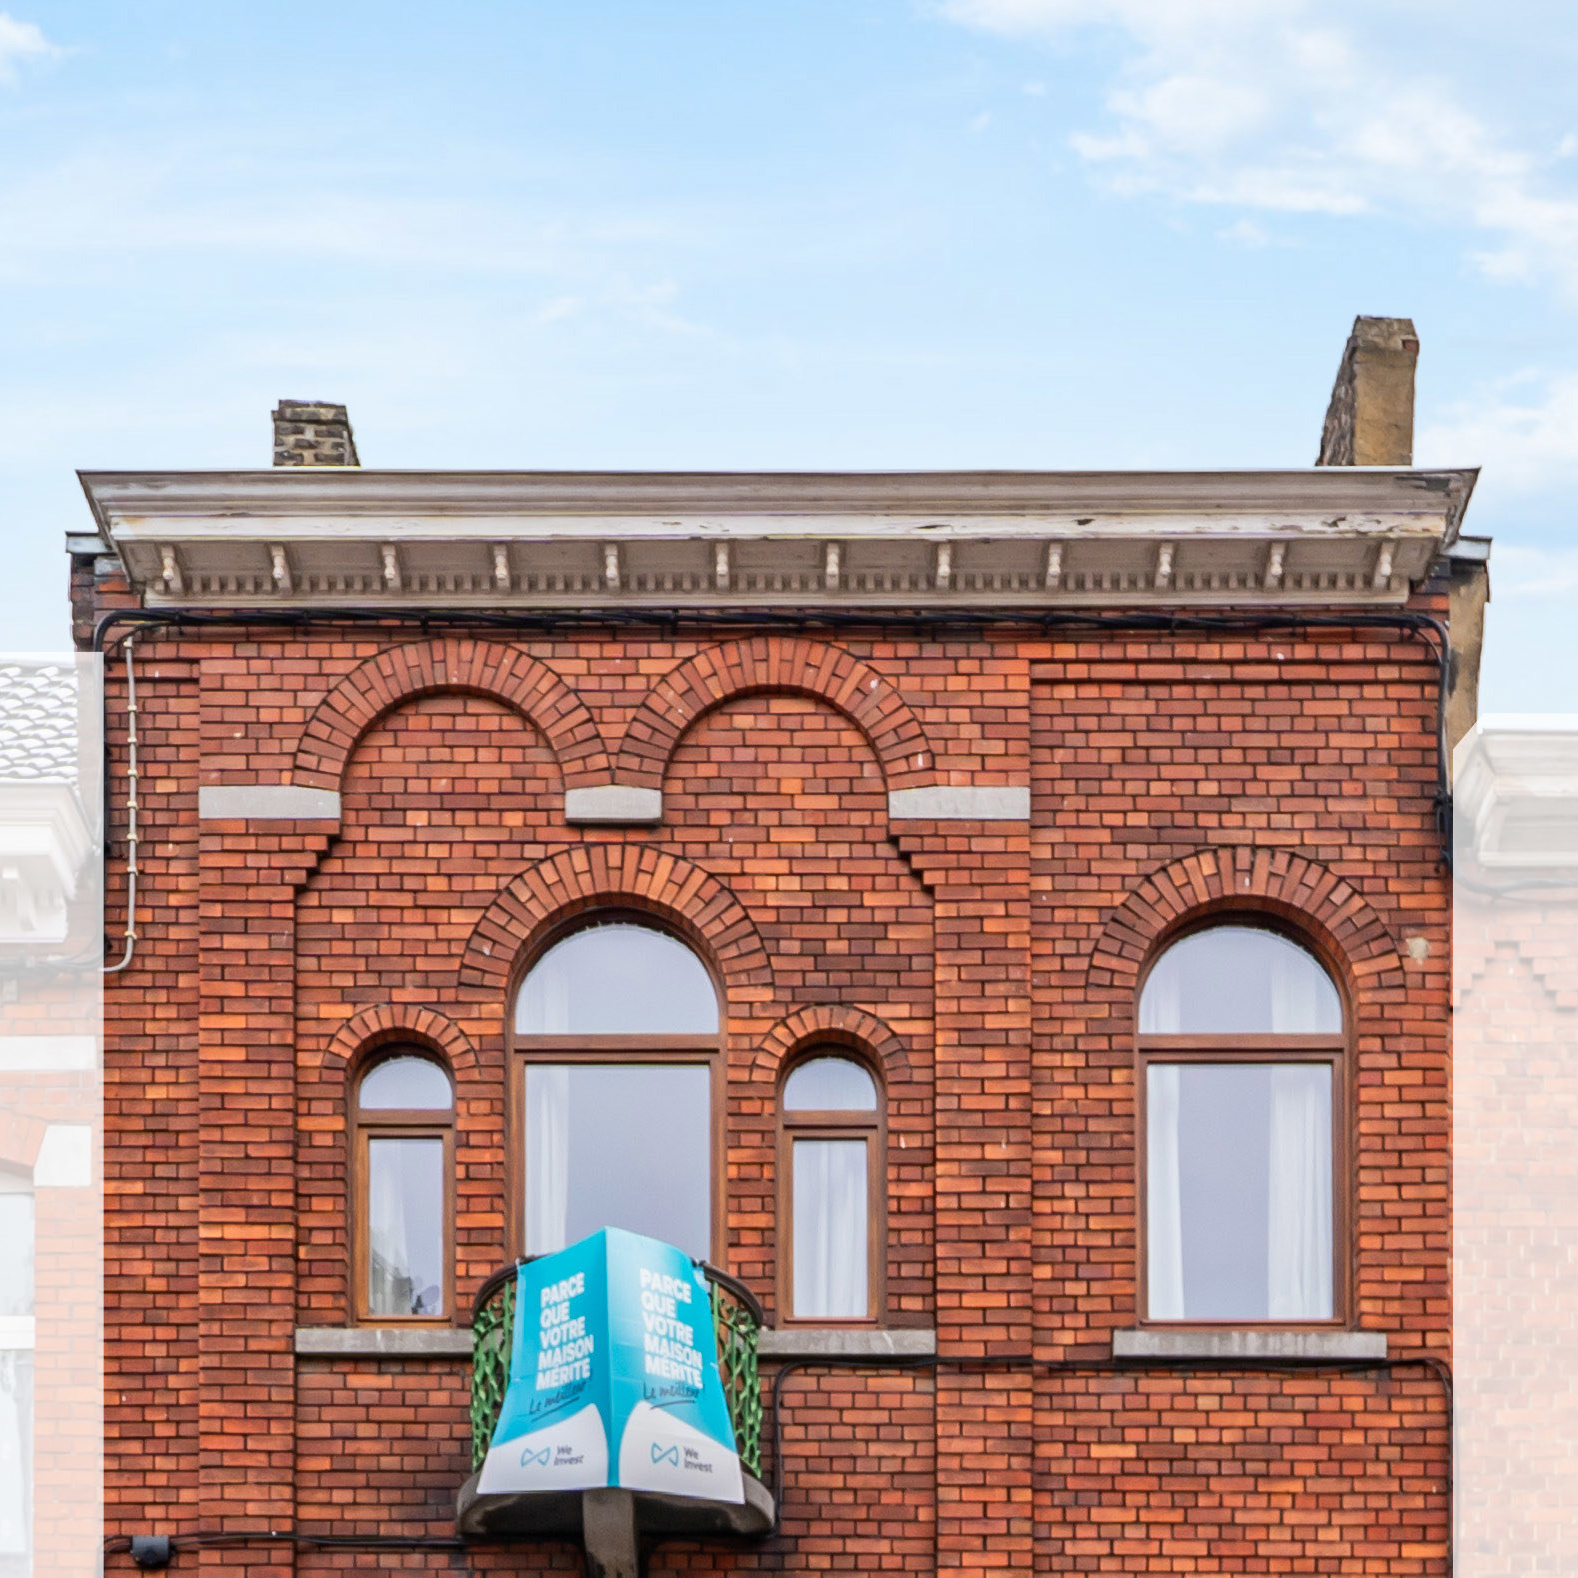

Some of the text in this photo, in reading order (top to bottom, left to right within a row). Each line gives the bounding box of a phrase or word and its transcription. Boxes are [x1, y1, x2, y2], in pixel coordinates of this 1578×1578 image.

[540, 1271, 585, 1308] PARCE
[639, 1267, 692, 1305] PARCE
[540, 1300, 570, 1328] QUE
[641, 1290, 677, 1318] QUE
[539, 1315, 586, 1349] VOTRE
[641, 1310, 694, 1347] VOTRE
[537, 1334, 594, 1371] MAISON
[643, 1332, 703, 1370] MAISON
[556, 1444, 573, 1455] We
[683, 1446, 699, 1460] We
